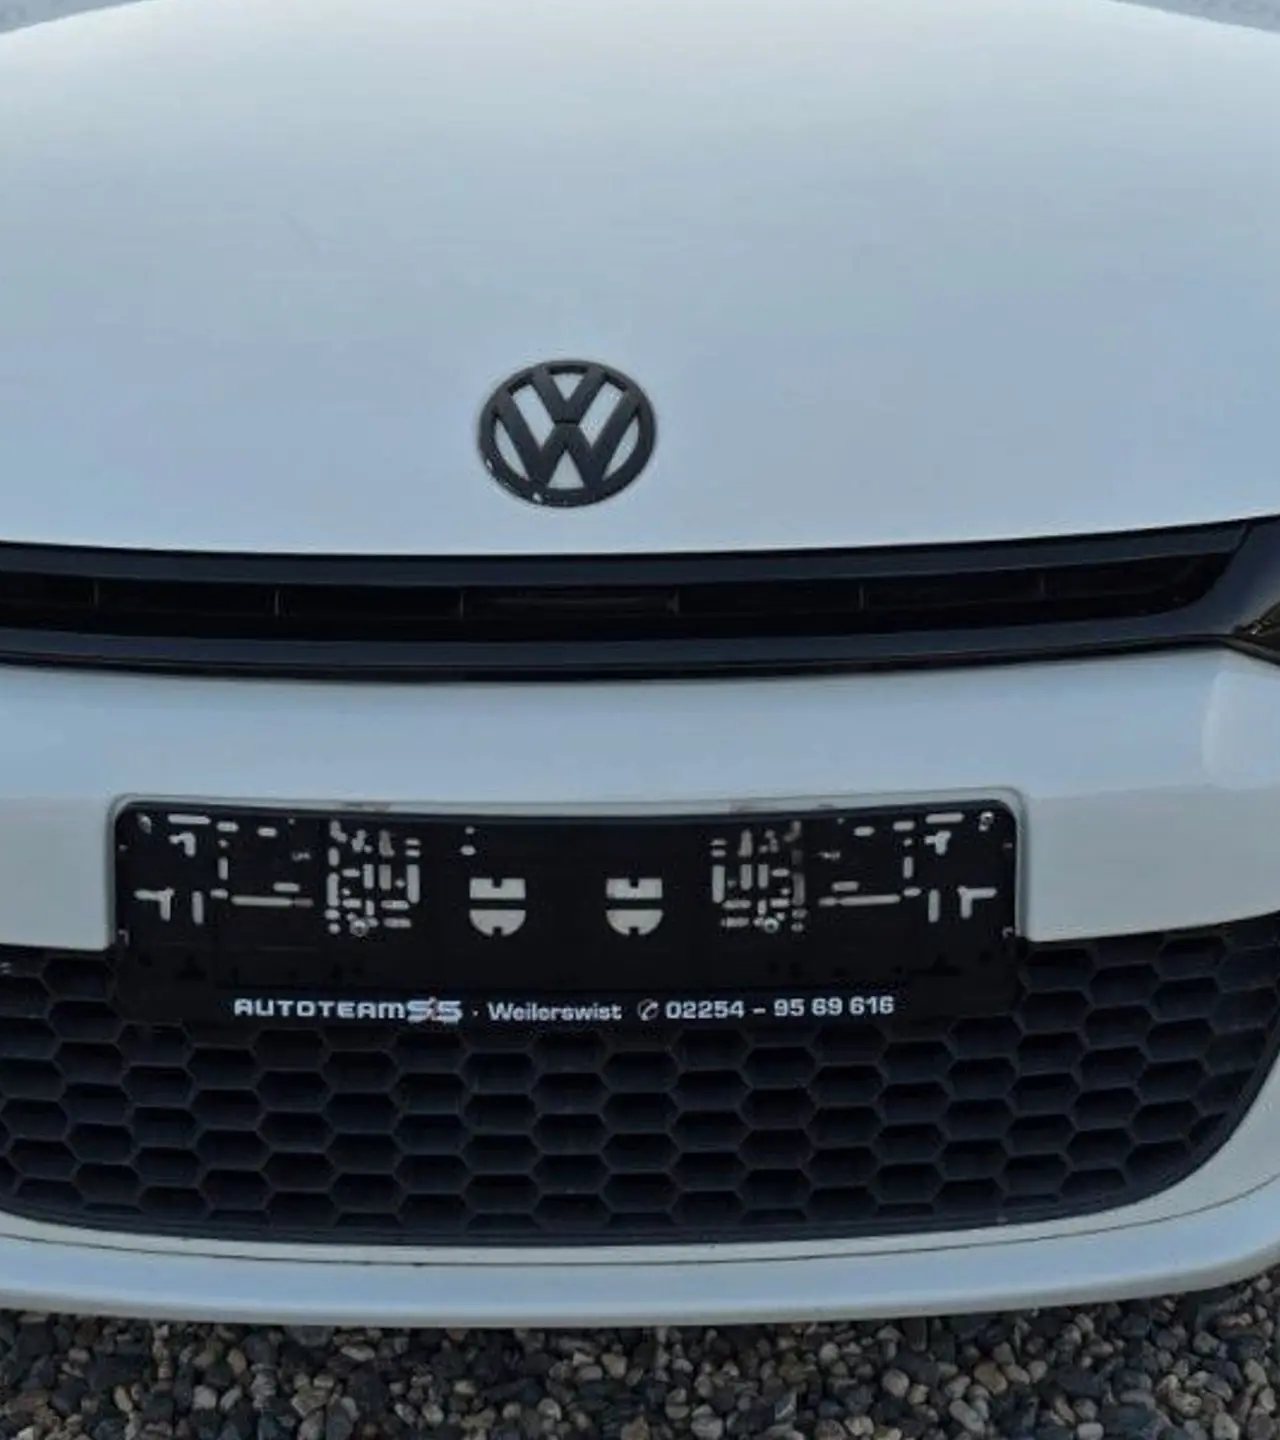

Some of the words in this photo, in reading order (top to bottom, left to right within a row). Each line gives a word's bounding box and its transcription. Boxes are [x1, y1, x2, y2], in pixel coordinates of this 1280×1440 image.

[479, 359, 656, 508] VW
[487, 1002, 622, 1022] Weilerswist
[665, 1000, 746, 1020] 02254
[773, 998, 805, 1018] 95
[811, 997, 843, 1017] 69
[849, 995, 895, 1016] 616
